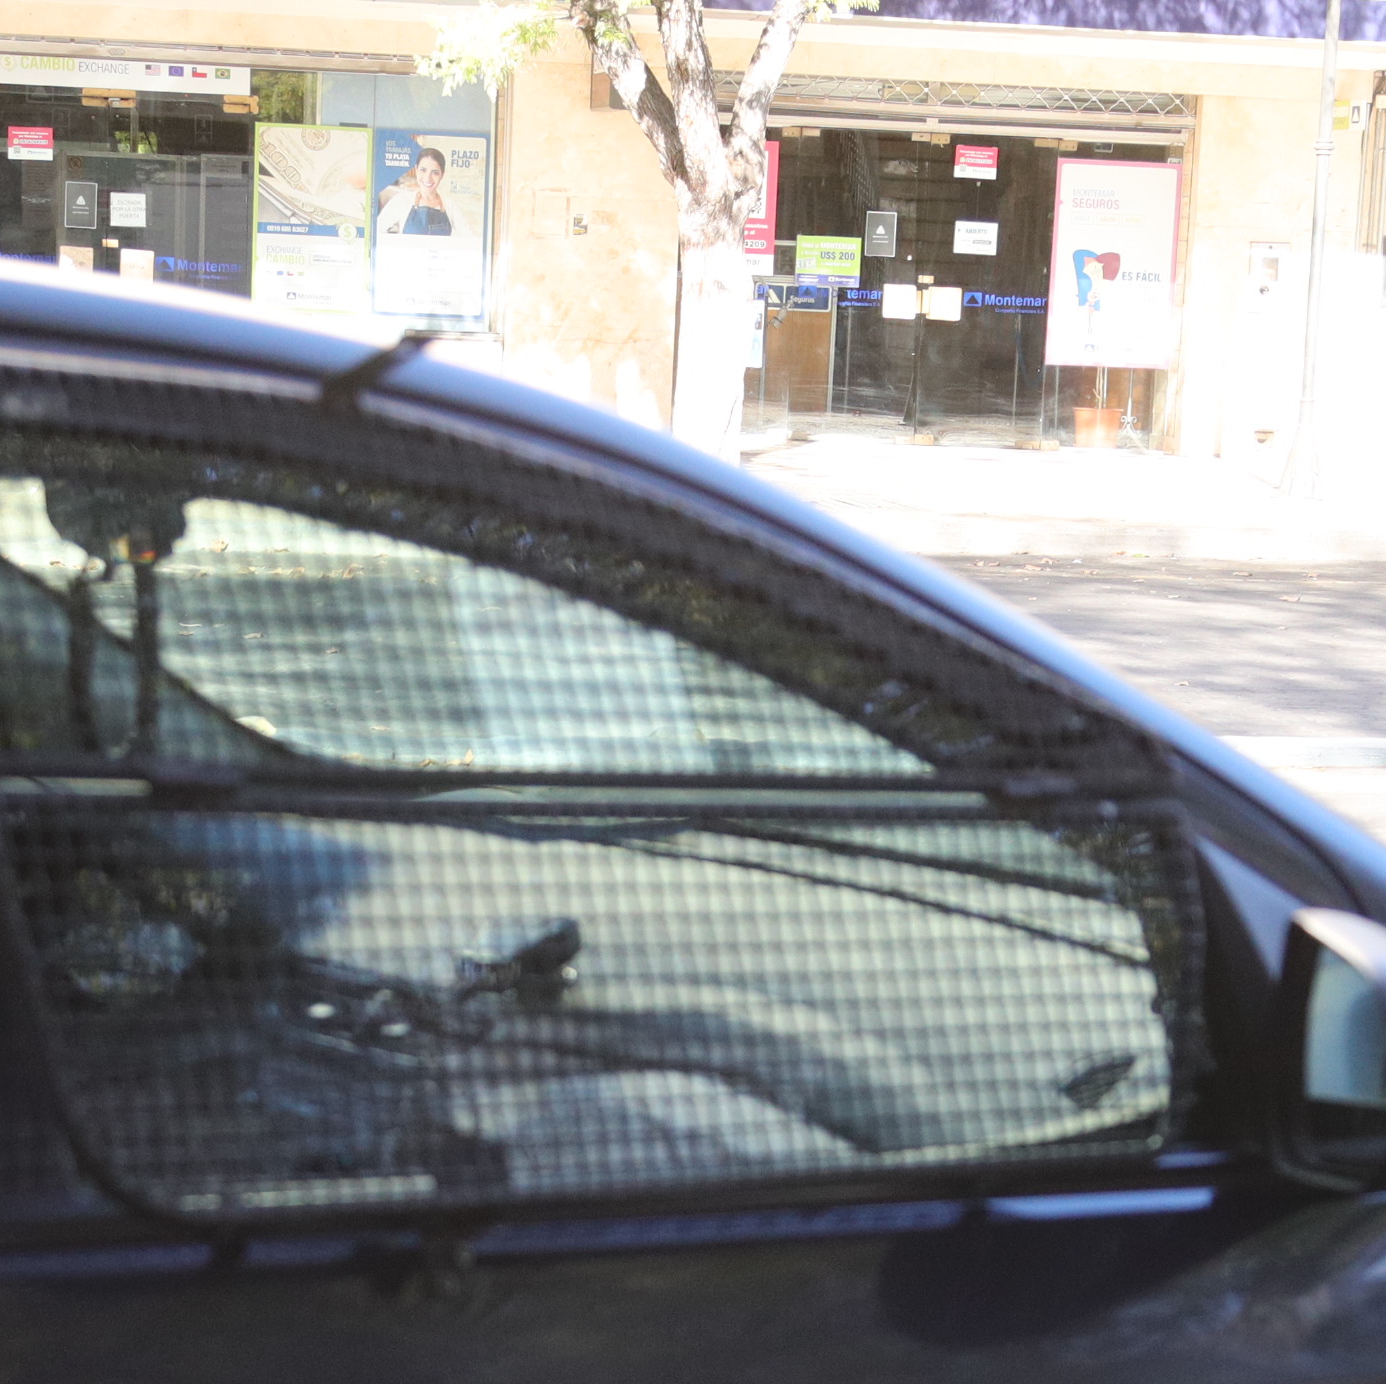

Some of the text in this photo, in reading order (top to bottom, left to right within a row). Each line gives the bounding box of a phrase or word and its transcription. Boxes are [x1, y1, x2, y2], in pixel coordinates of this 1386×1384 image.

[20, 54, 76, 72] CAMBIO
[78, 61, 130, 75] EXCHANGE
[451, 149, 480, 160] PLAZO
[451, 158, 471, 168] FIJO
[1072, 189, 1115, 198] MONTEMAR
[1072, 198, 1120, 210] SEGUROS
[266, 245, 303, 255] EXCHANGE
[266, 253, 305, 266] CAMBIO
[820, 251, 837, 261] US$
[838, 251, 855, 261] 200
[177, 259, 242, 274] Montemar
[1121, 269, 1162, 283] ES FÁCIL
[790, 294, 815, 304] Seguros
[984, 293, 1047, 307] Montemar
